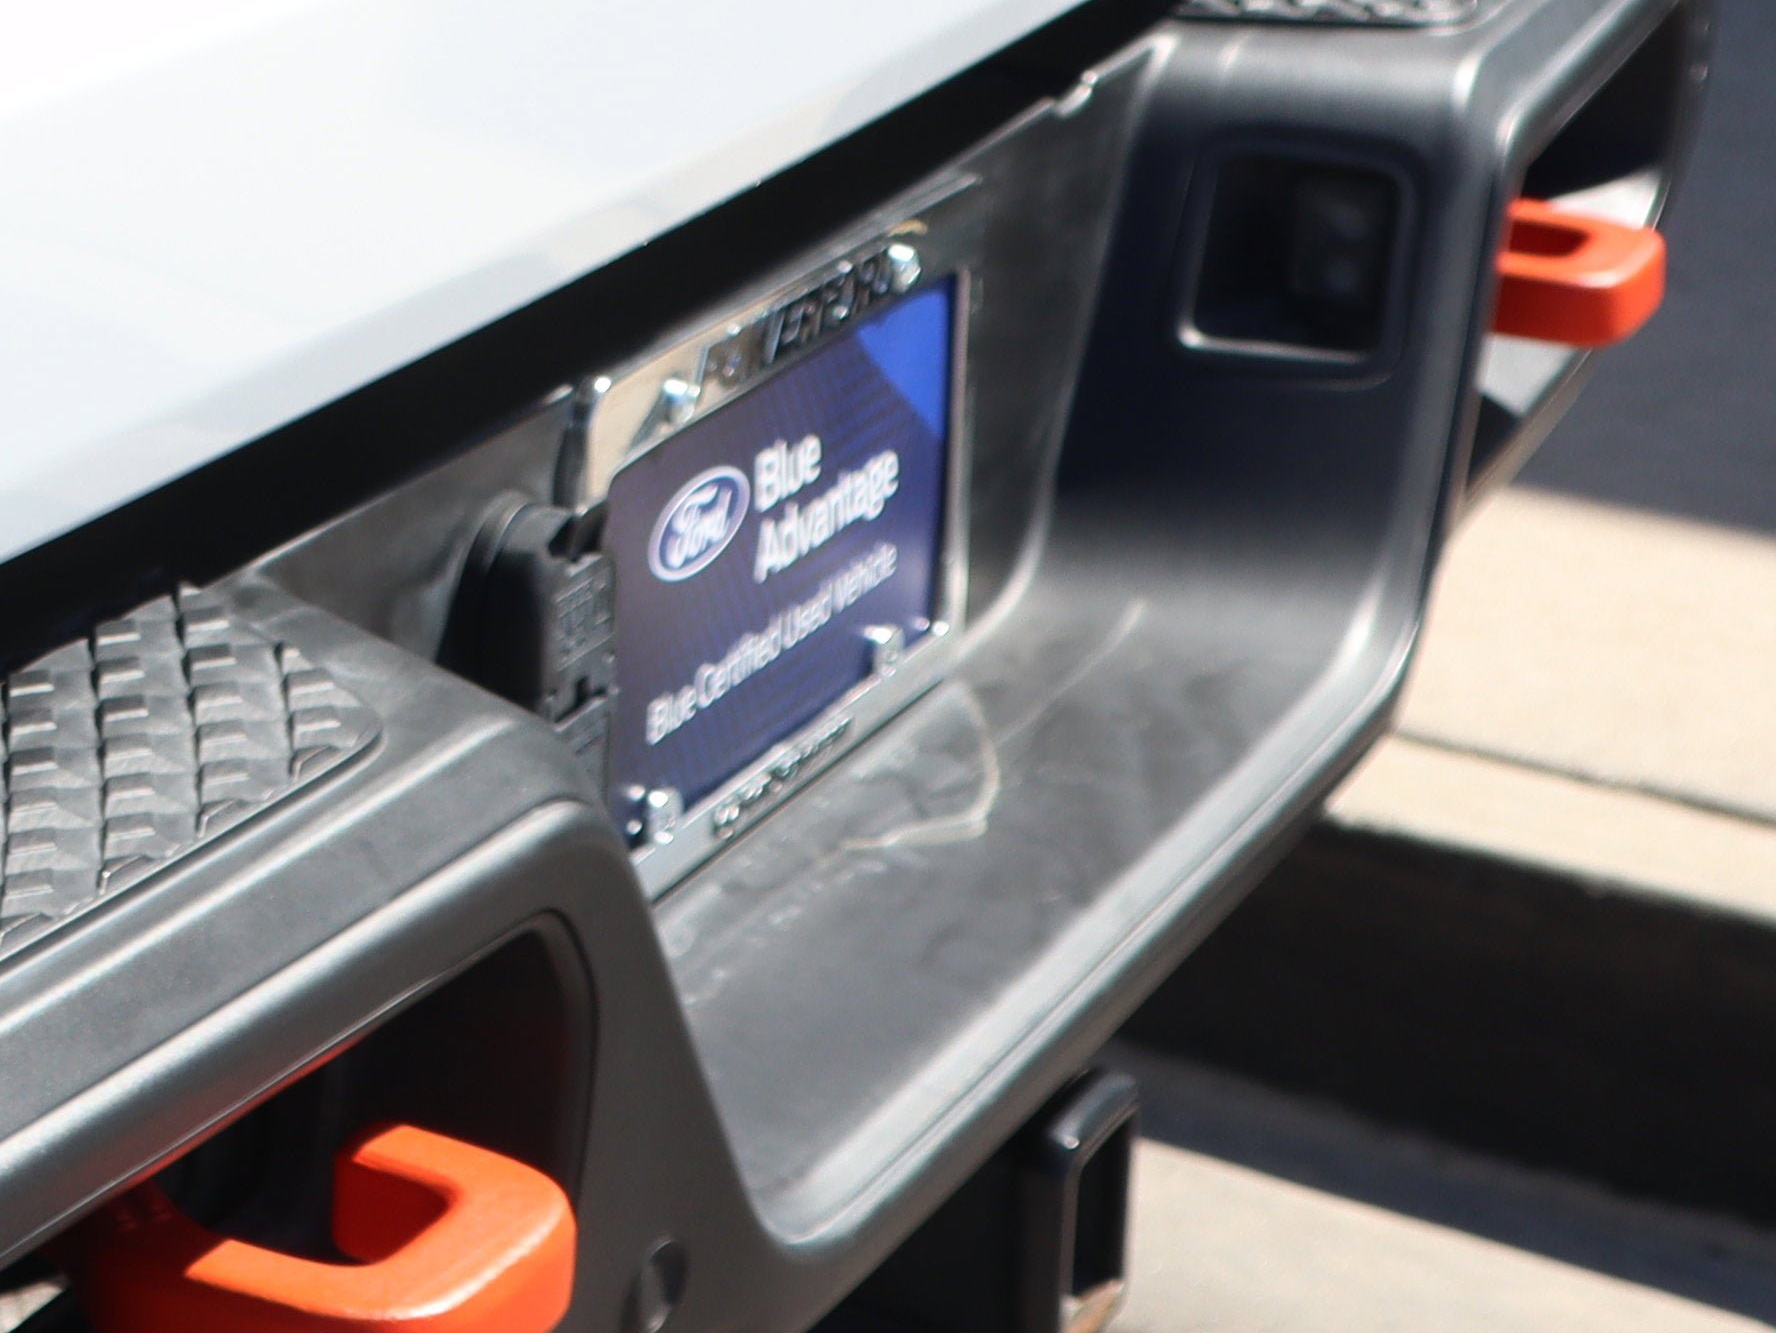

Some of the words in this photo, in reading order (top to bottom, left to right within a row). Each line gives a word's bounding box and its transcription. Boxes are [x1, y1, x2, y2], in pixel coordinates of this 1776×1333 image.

[665, 482, 734, 570] Ford
[752, 434, 823, 513] Blue
[752, 449, 901, 585] Advantage
[645, 690, 697, 747] Blue
[694, 617, 783, 709] Certified
[783, 580, 834, 650] Used
[833, 542, 900, 612] Vehicle
